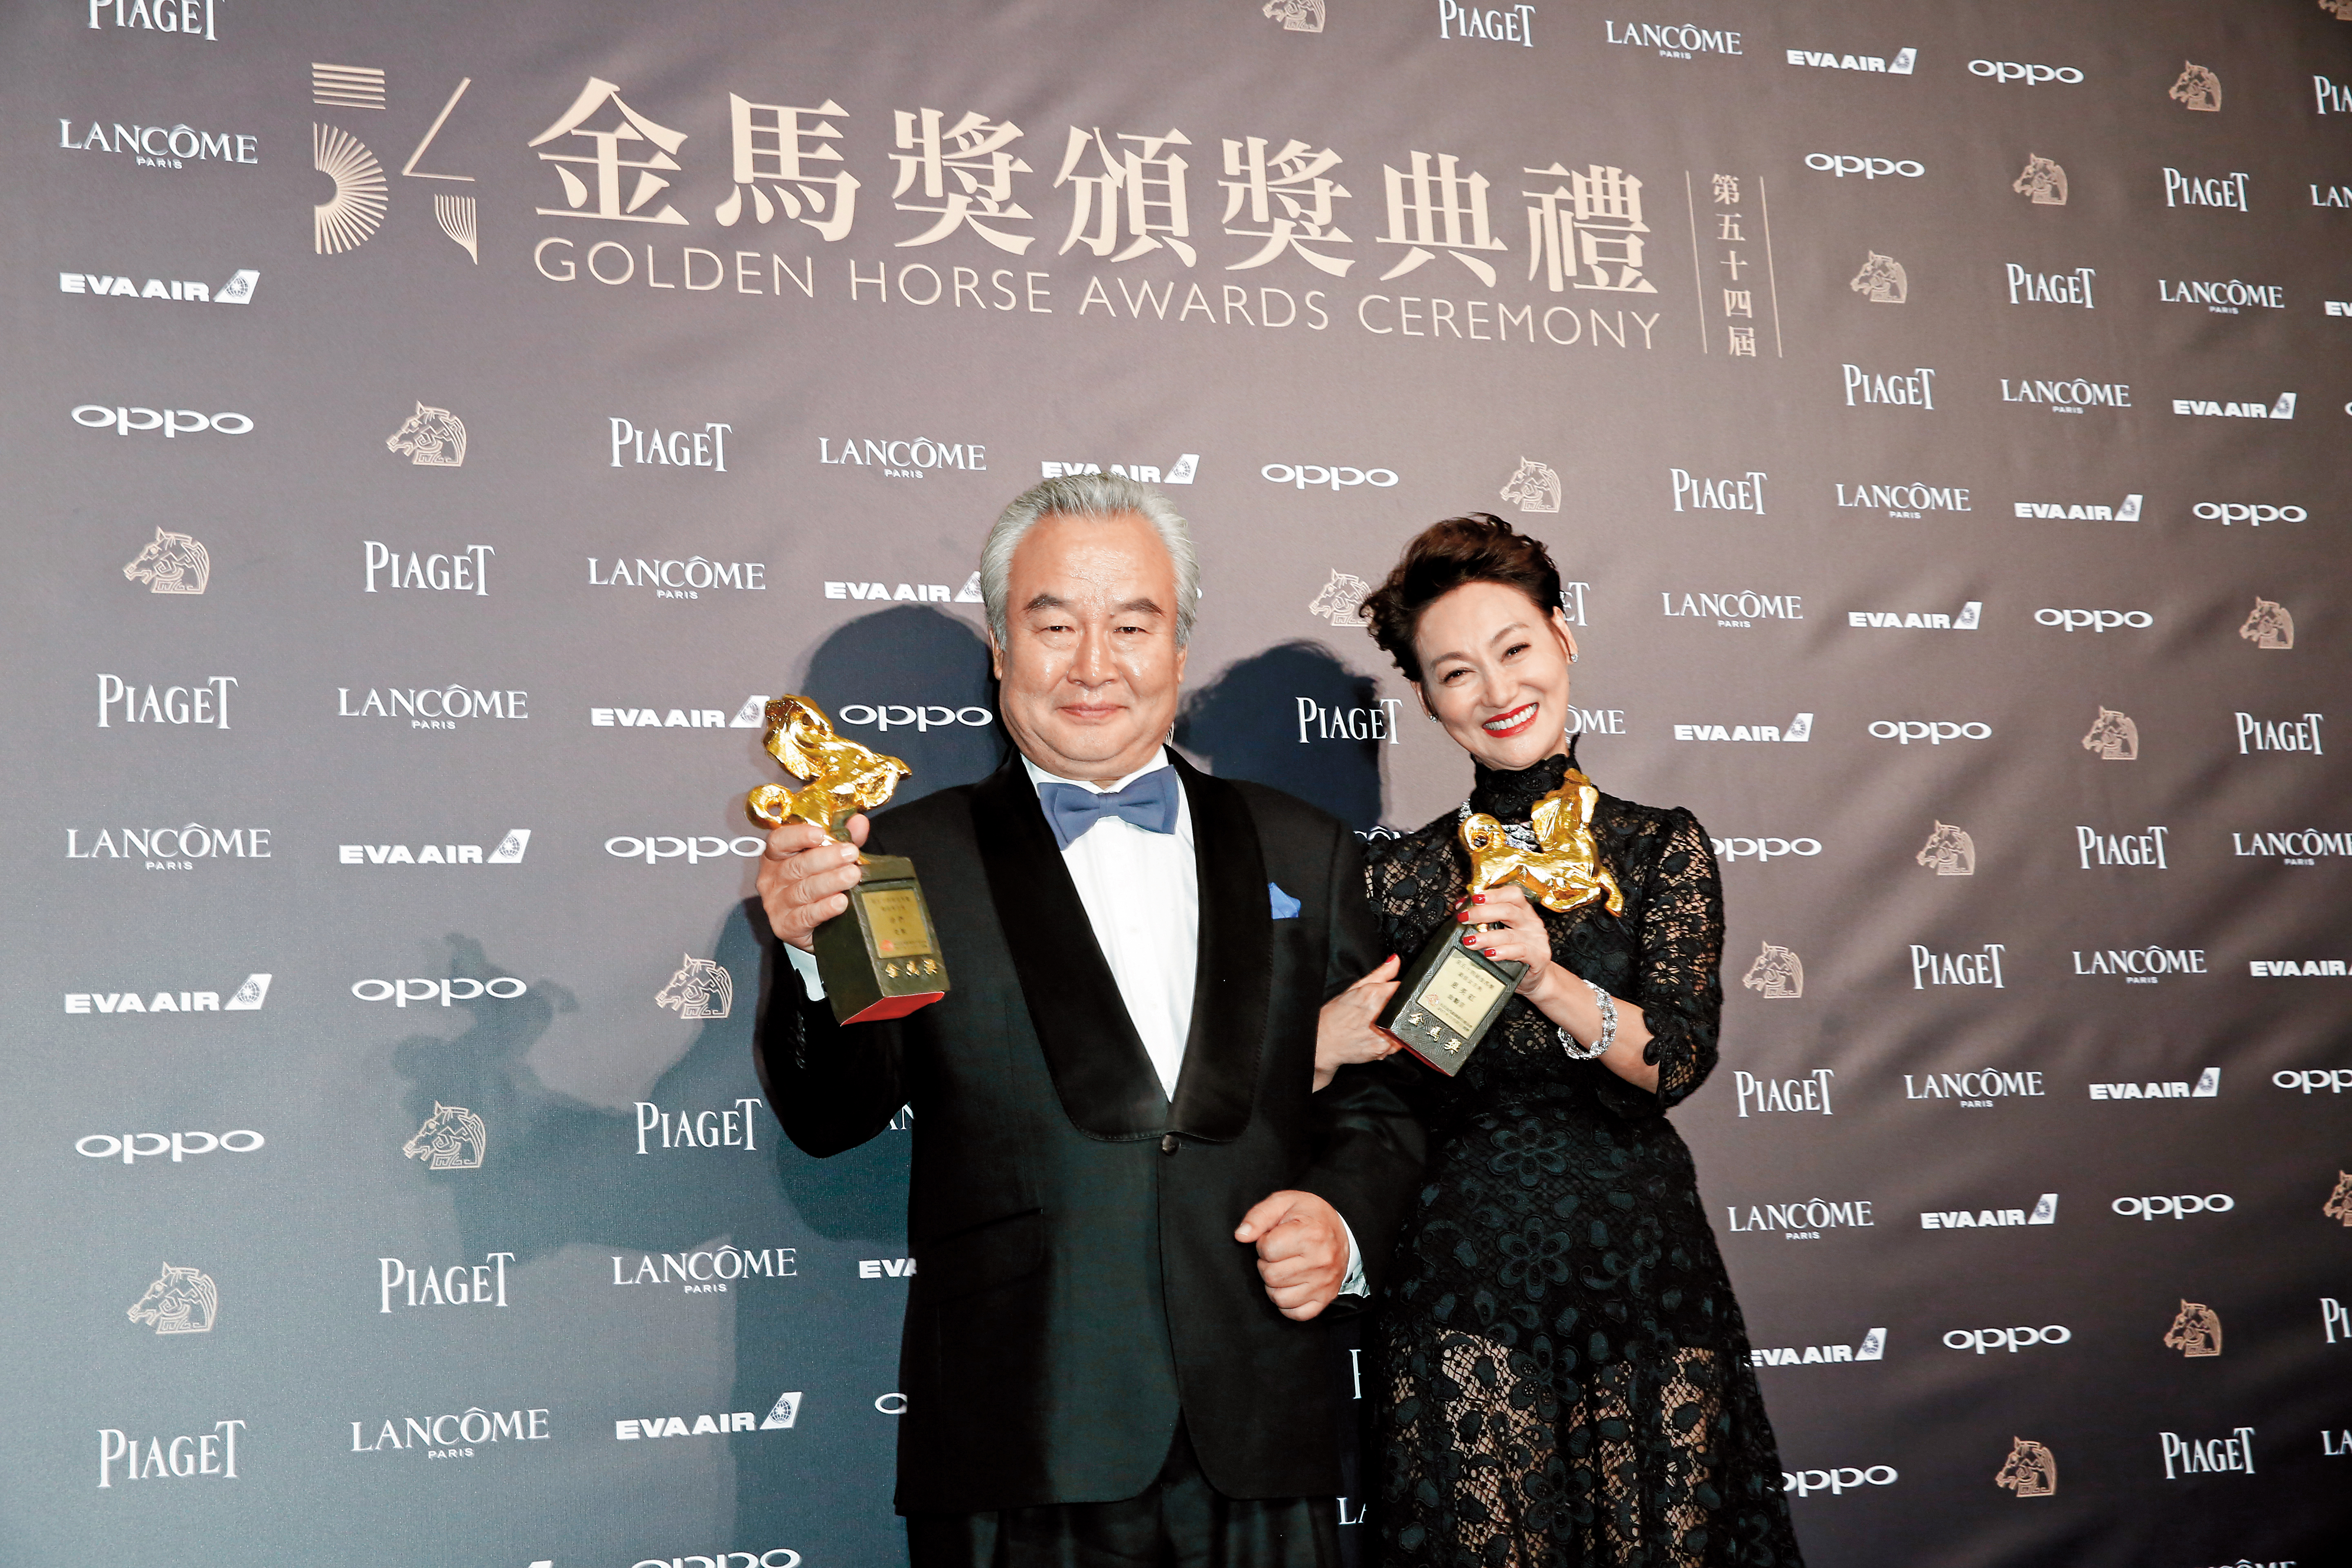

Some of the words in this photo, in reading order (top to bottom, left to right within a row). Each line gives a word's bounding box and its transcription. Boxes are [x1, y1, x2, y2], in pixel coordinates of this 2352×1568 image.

[1439, 0, 1536, 47] PIAGET
[1606, 20, 1742, 56] LANCÔME
[1659, 50, 1691, 60] PARIS
[1968, 60, 2084, 85] oppo
[60, 118, 258, 164] LANCÔME
[136, 156, 183, 169] PARIS
[1805, 153, 1924, 179] oppo
[528, 76, 1659, 294] 金馬獎頒獎典禮
[2163, 167, 2249, 212] PIAGET
[1713, 174, 1756, 357] 第五十四屆
[535, 238, 813, 298] GOLDEN
[850, 259, 1052, 313] HORSE
[1079, 276, 1328, 330] AWARDS
[1359, 294, 1660, 349] CEREMONY
[2006, 263, 2095, 308] PIAGET
[2159, 279, 2285, 309] LANCÔME
[2209, 306, 2238, 314] PARIS
[1842, 364, 1935, 410] PIAGET
[2000, 378, 2132, 407] LANCÔME
[71, 405, 254, 438] oppo
[609, 417, 733, 472] PIAGET
[819, 436, 987, 470] LANCÔME
[884, 469, 923, 479] PARIS
[1261, 464, 1399, 491] oppo
[1670, 468, 1768, 514] PIAGET
[1835, 482, 1971, 511] LANCÔME
[1889, 511, 1921, 519] PARIS
[2193, 502, 2307, 526] oppo
[364, 541, 495, 596] PIAGET
[587, 555, 766, 590] LANCÔME
[656, 589, 698, 599] PARIS
[1662, 590, 1803, 619] LANCÔME
[2034, 608, 2153, 633] oppo
[97, 674, 238, 729] PIAGET
[338, 684, 528, 719] LANCÔME
[411, 720, 456, 729] PARIS
[839, 705, 993, 732] oppo
[1296, 697, 1403, 744] PIAGET
[1868, 721, 1992, 745] oppo
[2235, 712, 2323, 755] PIAGET
[66, 822, 271, 858] LANCÔME
[605, 836, 766, 864] oppo
[2076, 826, 2167, 869] PIAGET
[146, 861, 193, 870] PARIS
[1909, 944, 2005, 989] PIAGET
[2072, 945, 2207, 974] LANCÔME
[351, 977, 527, 1008] oppo
[1733, 1069, 1834, 1117] PIAGET
[1904, 1067, 2045, 1099] LANCÔME
[633, 1098, 762, 1154] PIAGET
[76, 1130, 265, 1164] oppo
[1727, 1198, 1874, 1231] LANCÔME
[2112, 1194, 2234, 1221] oppo
[1786, 1232, 1820, 1240] PARIS
[610, 1245, 797, 1285] LANCÔME
[378, 1252, 515, 1313] PIAGET
[684, 1283, 727, 1293] PARIS
[1943, 1325, 2071, 1354] oppo
[350, 1407, 549, 1450] LANCÔME
[97, 1420, 246, 1488] PIAGET
[428, 1448, 473, 1459] PARIS
[2159, 1427, 2255, 1479] PIAGET
